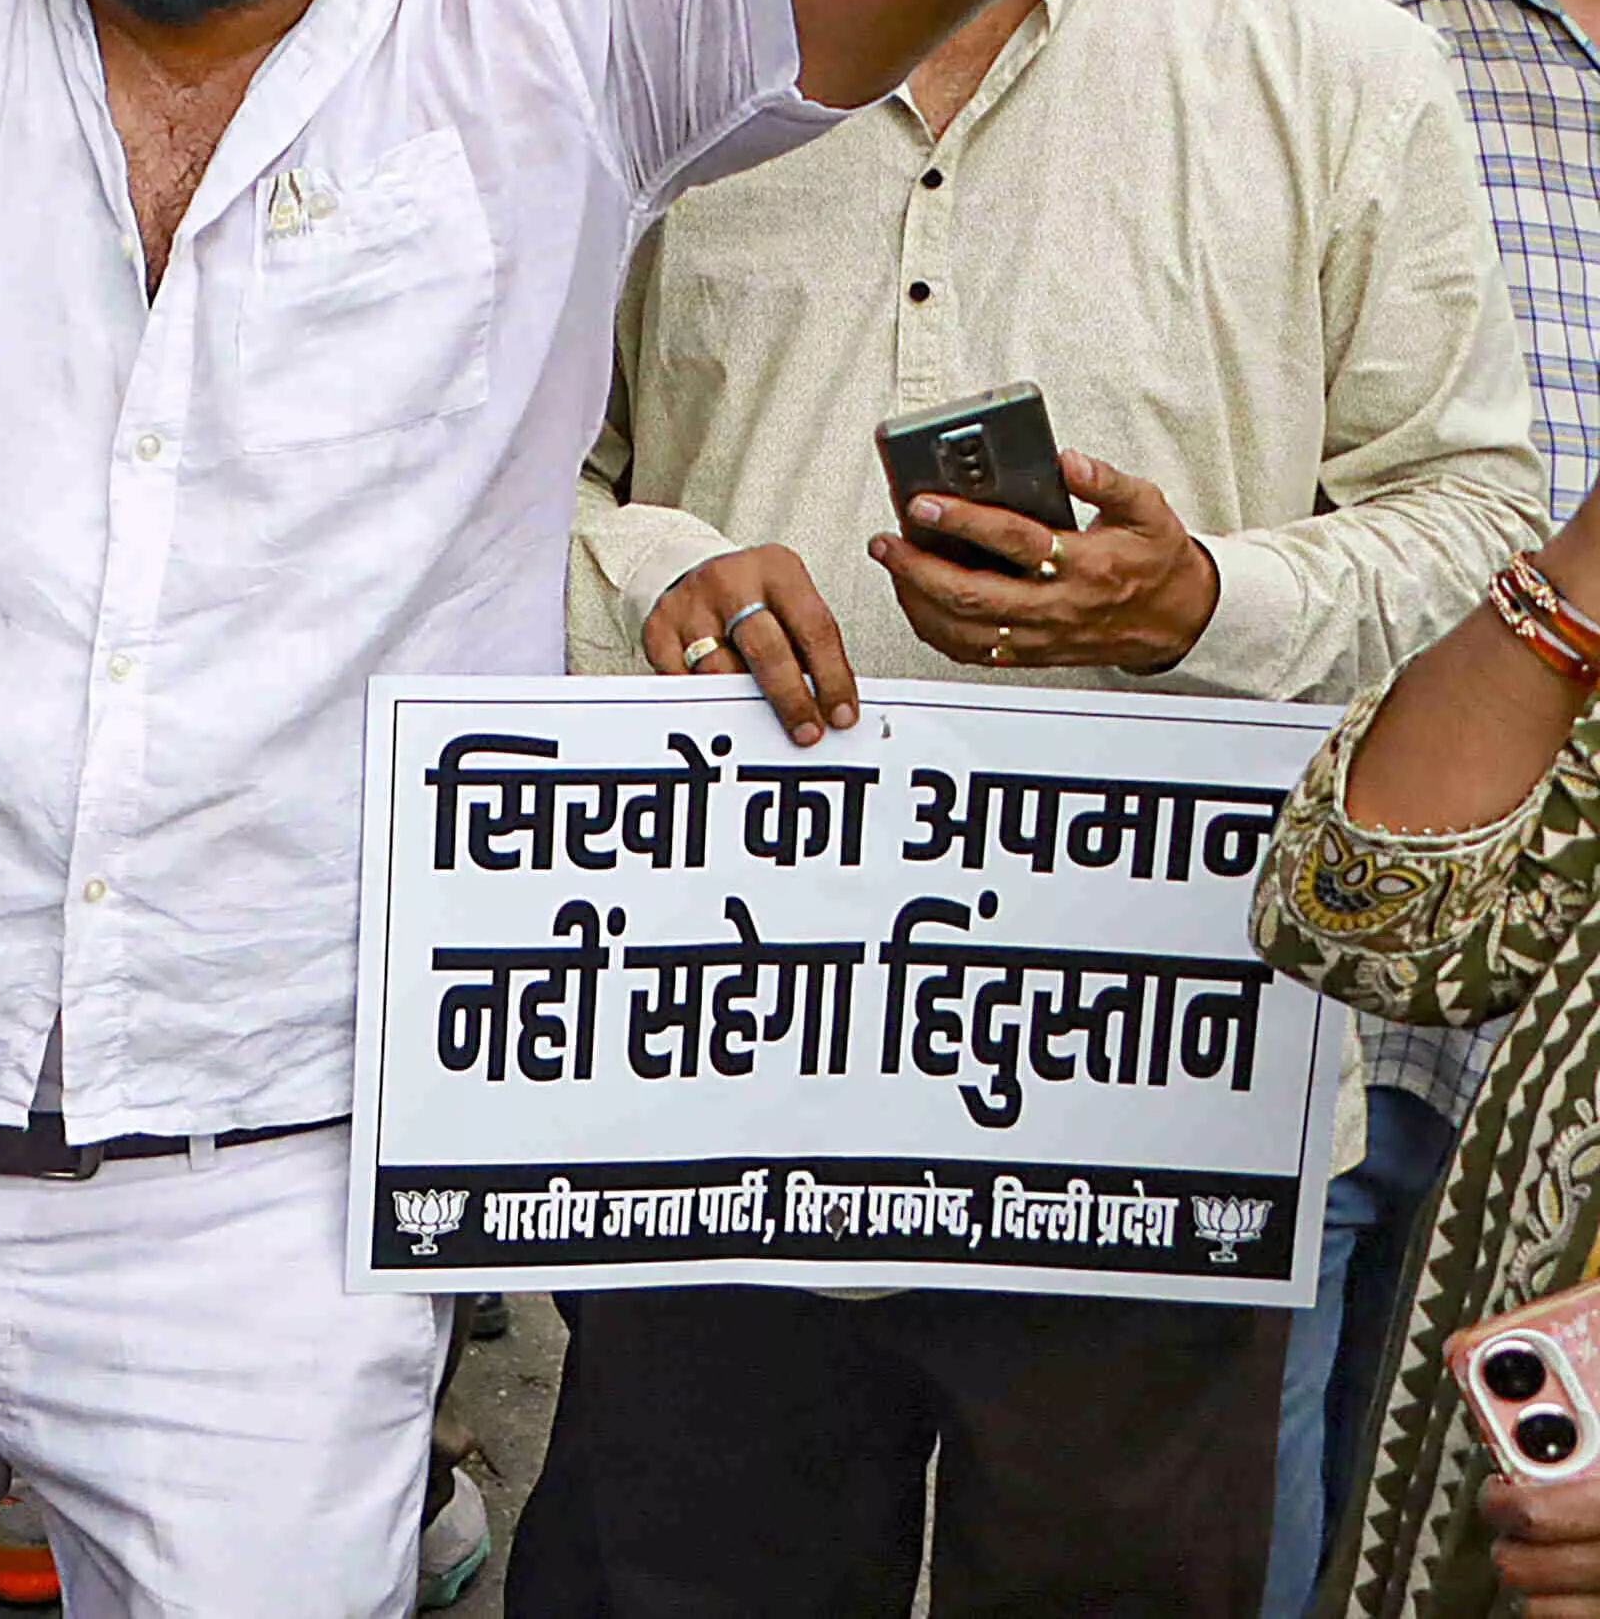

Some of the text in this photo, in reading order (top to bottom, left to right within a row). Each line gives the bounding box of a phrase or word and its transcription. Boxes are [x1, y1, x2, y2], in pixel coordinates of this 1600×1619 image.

[425, 733, 1291, 882] सिखों का अपमान
[432, 891, 1274, 1128] नहीं सहेगा हिंदुस्तान
[484, 1169, 1178, 1247] भारतीय जनता पार्टी, सिख प्रकोष्ठ, दिल्ली प्रदेश
